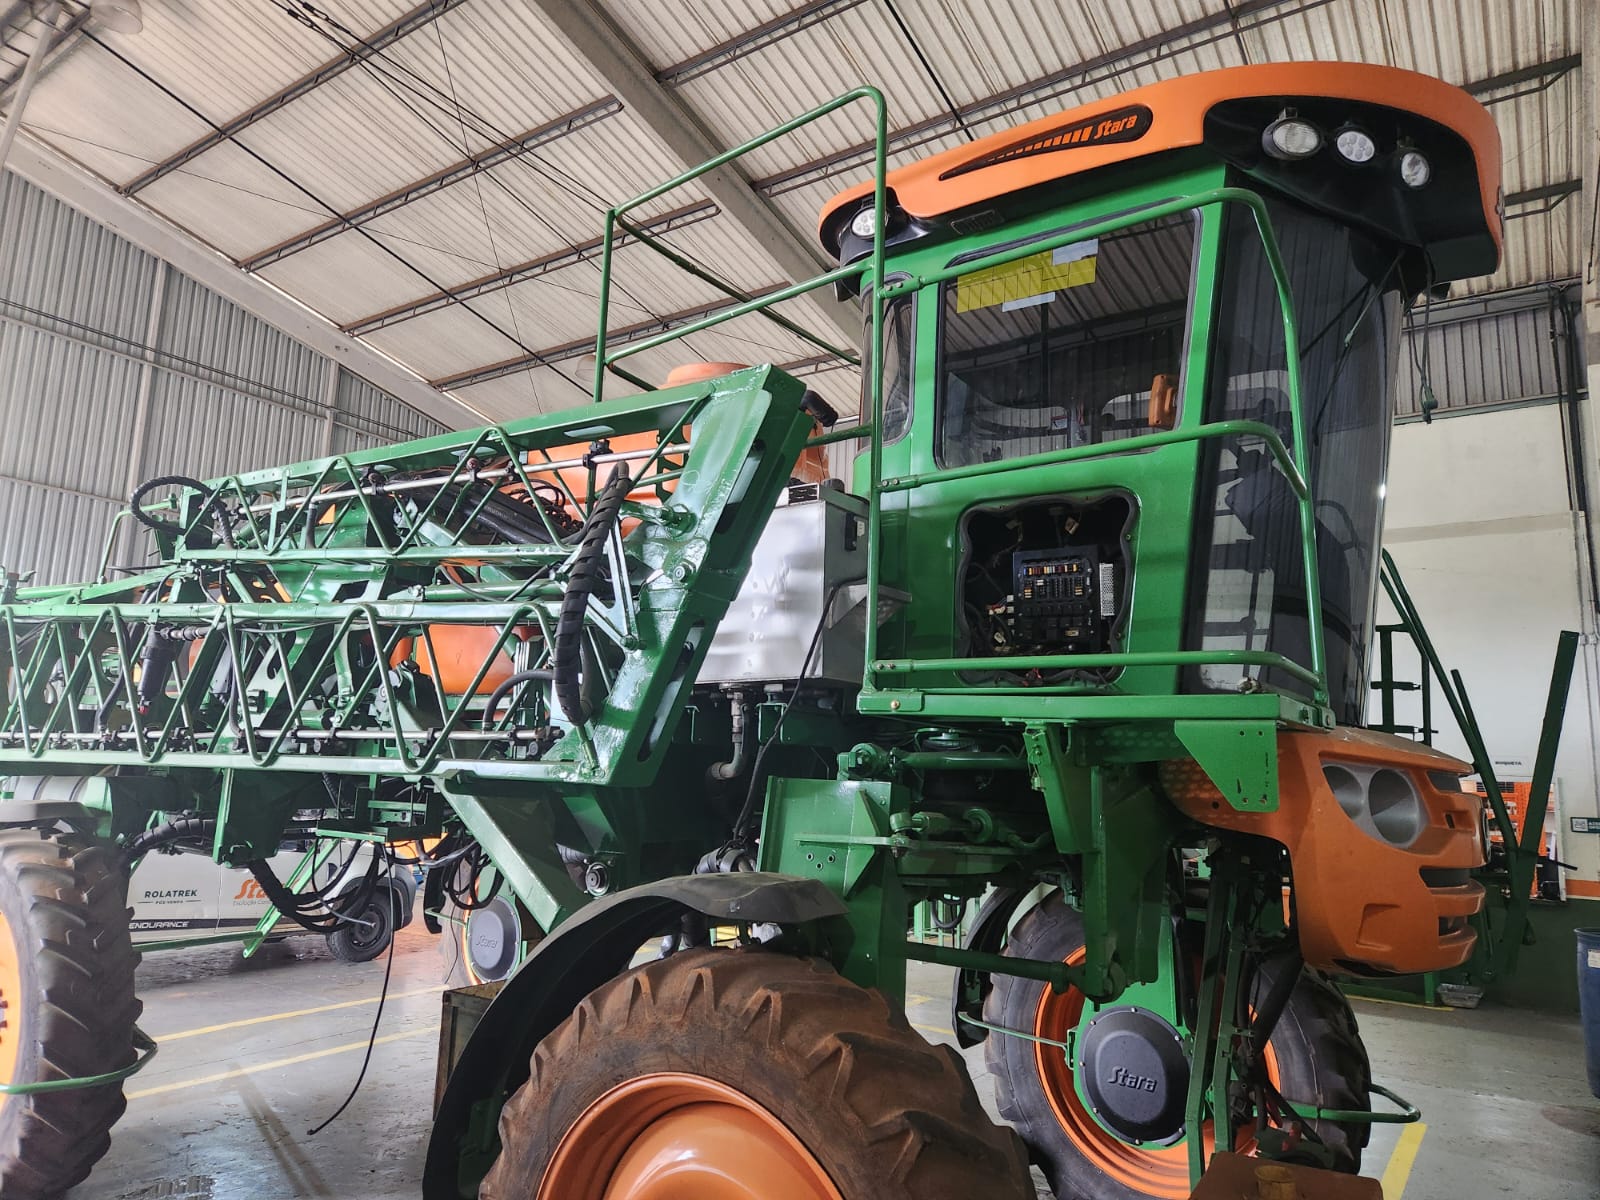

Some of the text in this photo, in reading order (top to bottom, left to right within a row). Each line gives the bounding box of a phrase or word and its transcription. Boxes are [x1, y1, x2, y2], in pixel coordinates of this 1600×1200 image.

[1093, 114, 1138, 139] Stara
[144, 889, 198, 898] ROLATREK
[233, 879, 268, 899] Sta
[128, 921, 190, 929] ENDURANCE
[1108, 1066, 1158, 1093] Stara
